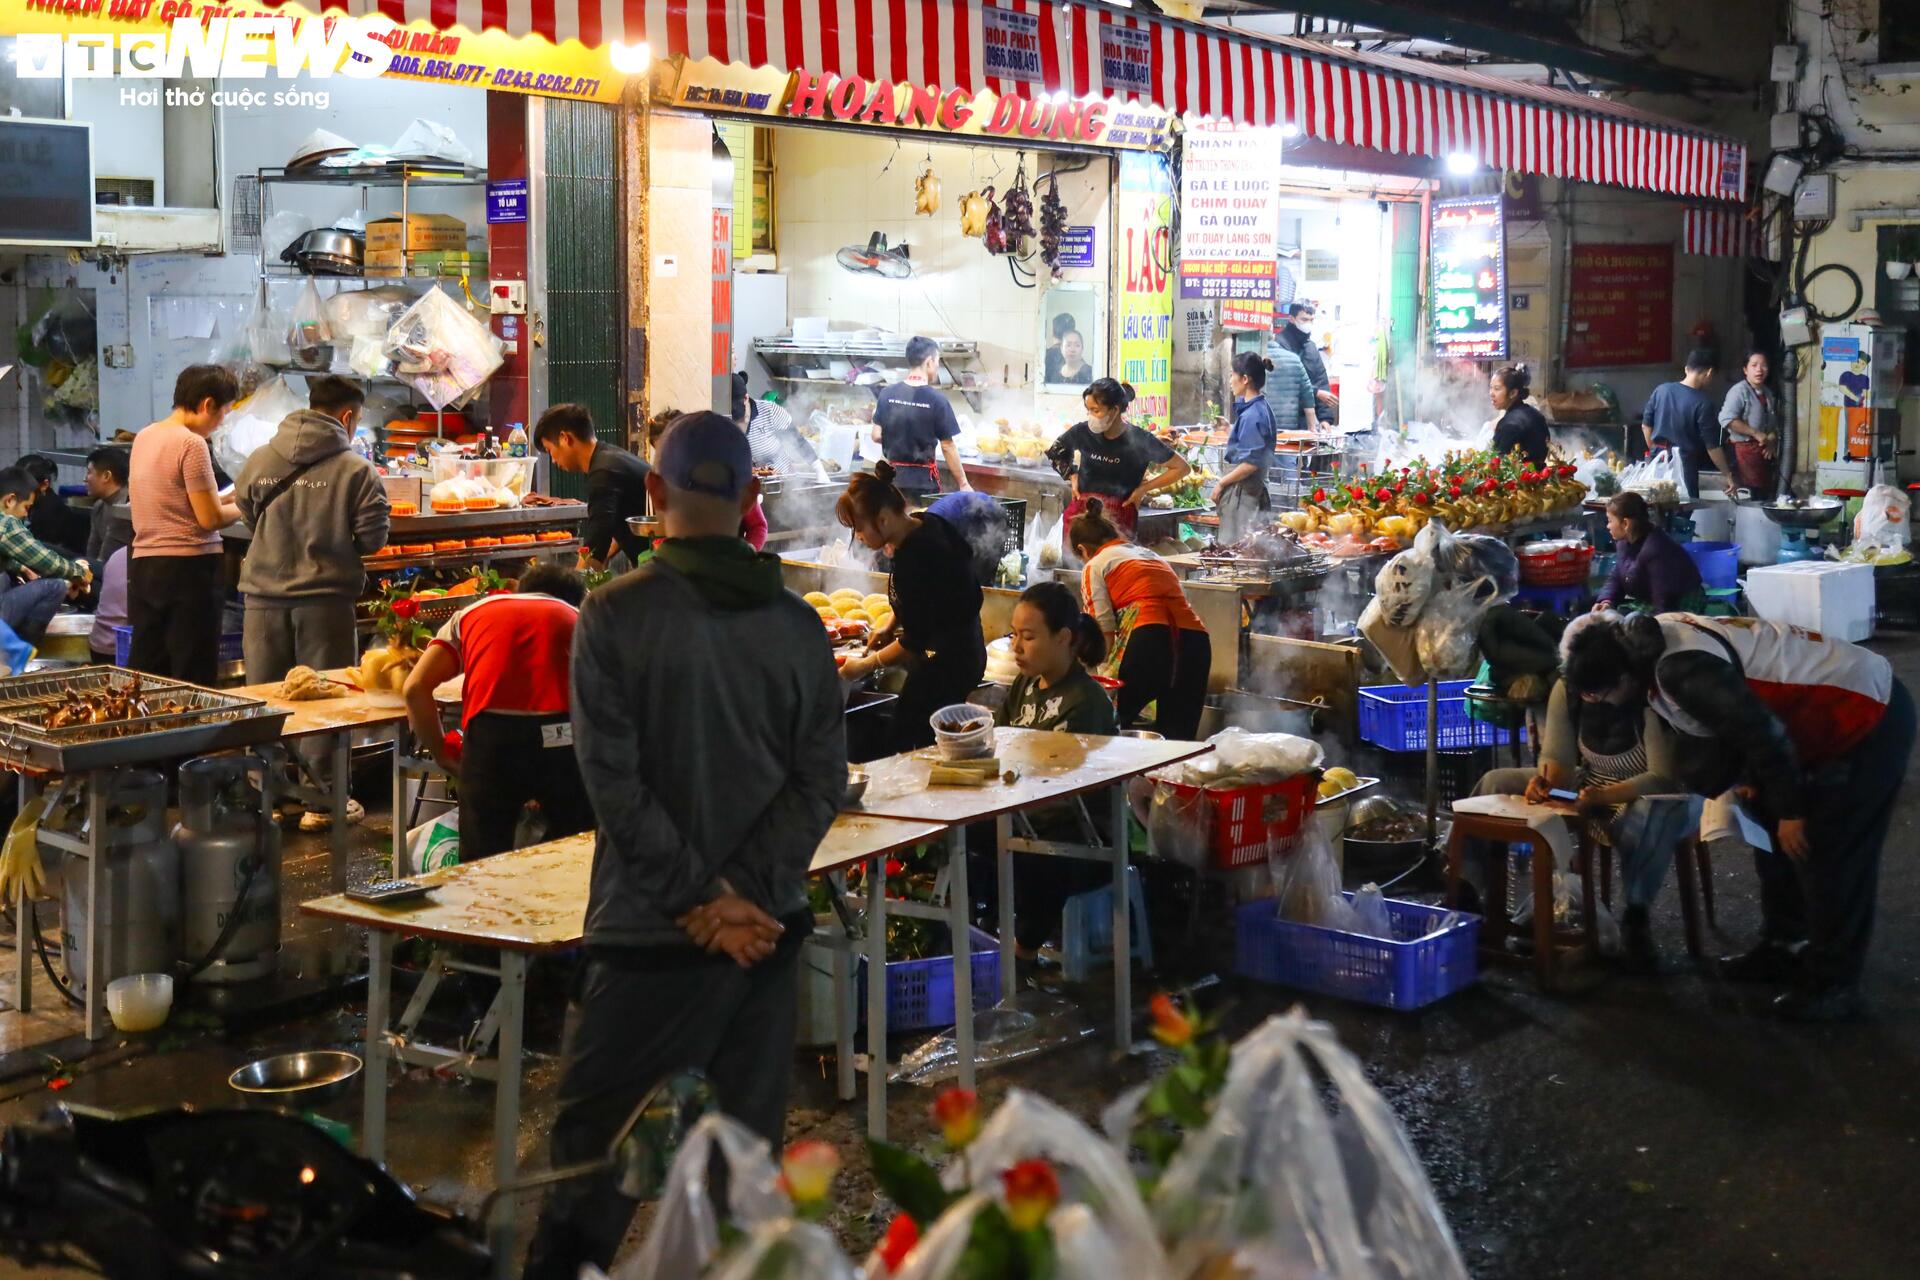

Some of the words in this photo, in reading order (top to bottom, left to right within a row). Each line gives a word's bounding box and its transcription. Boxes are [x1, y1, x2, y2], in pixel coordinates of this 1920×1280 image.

[986, 26, 1007, 47] HÒA
[1010, 31, 1036, 51] PHÁT
[1190, 178, 1208, 191] GÀ
[1191, 198, 1228, 209] CHIM
[1233, 198, 1268, 209] QUAY
[1200, 213, 1218, 226] GÀ
[1223, 215, 1258, 227] QUAY
[1203, 233, 1224, 245] QUAY
[1202, 279, 1228, 288] 0978
[1230, 279, 1256, 289] 5555
[1202, 288, 1228, 297] 0912
[1229, 288, 1249, 298] 287
[1251, 288, 1271, 298] 640
